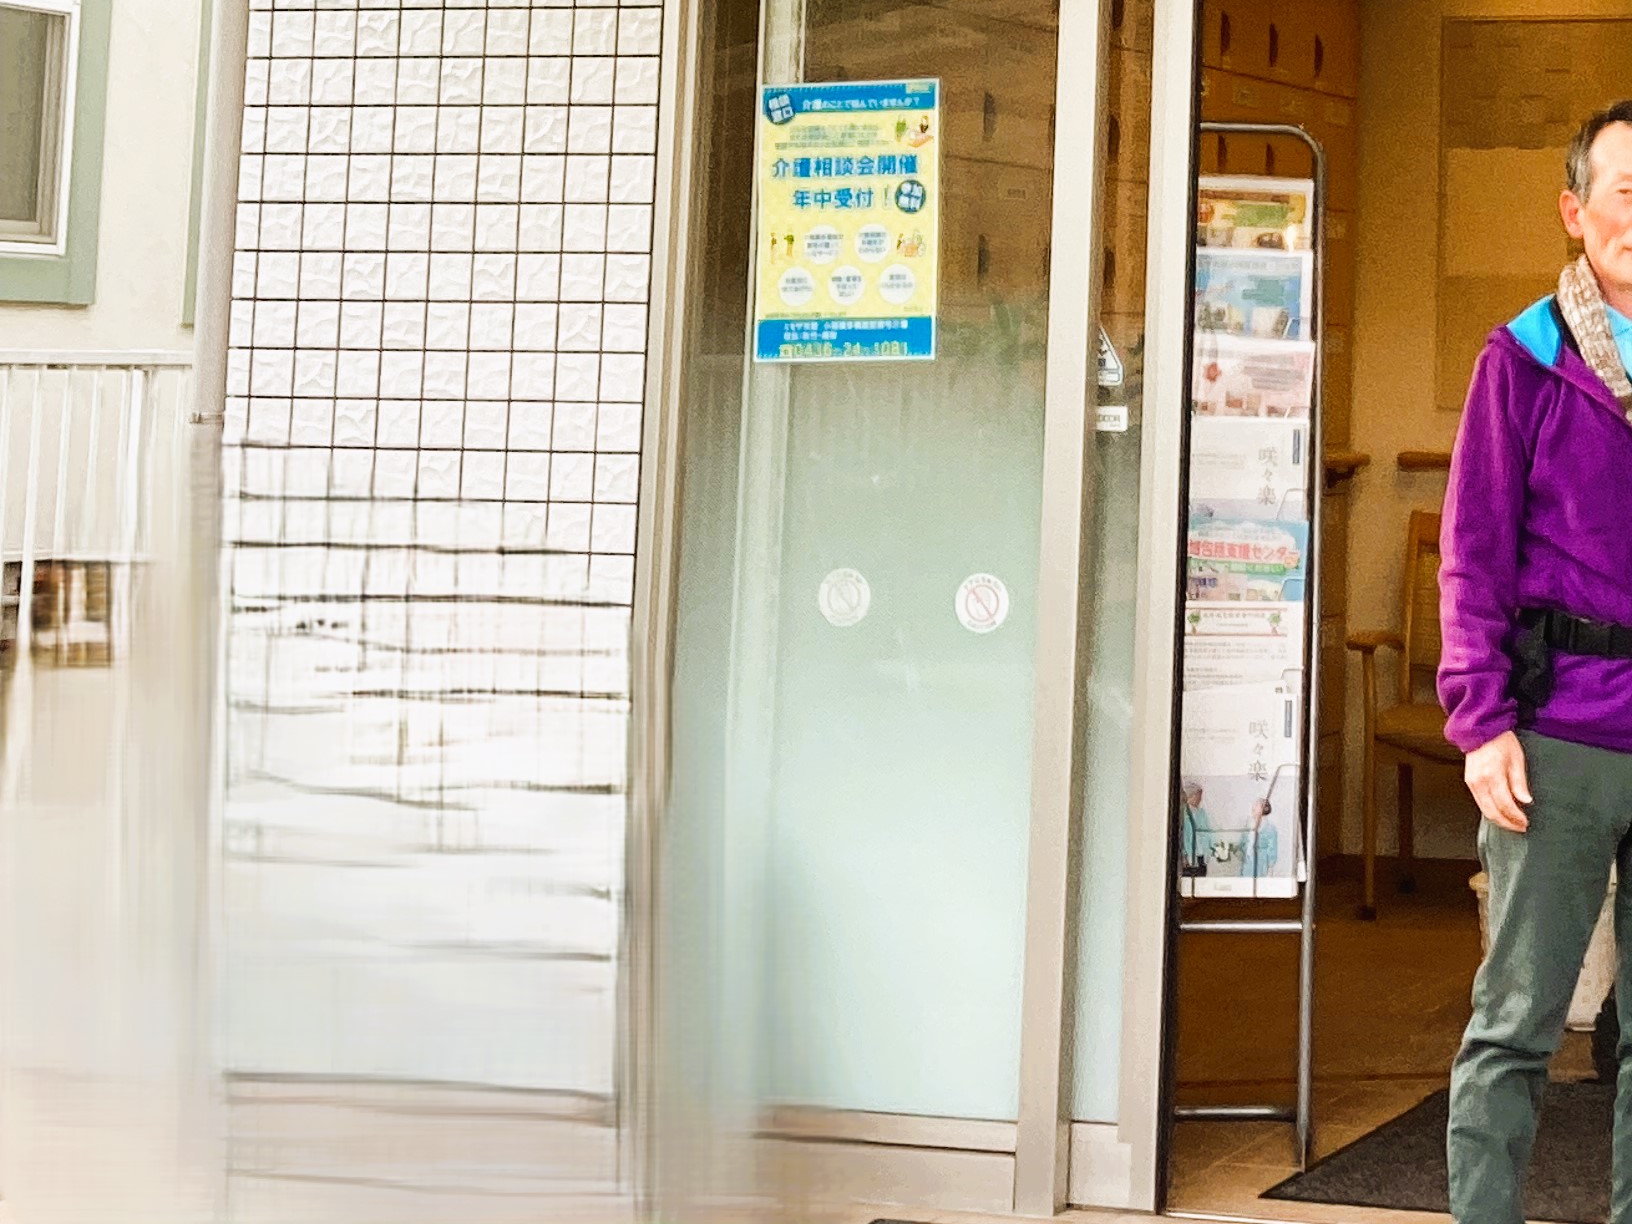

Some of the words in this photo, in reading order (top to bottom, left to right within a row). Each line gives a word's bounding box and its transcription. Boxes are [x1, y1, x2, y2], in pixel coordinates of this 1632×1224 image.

[772, 154, 919, 178] 介護相談会開催
